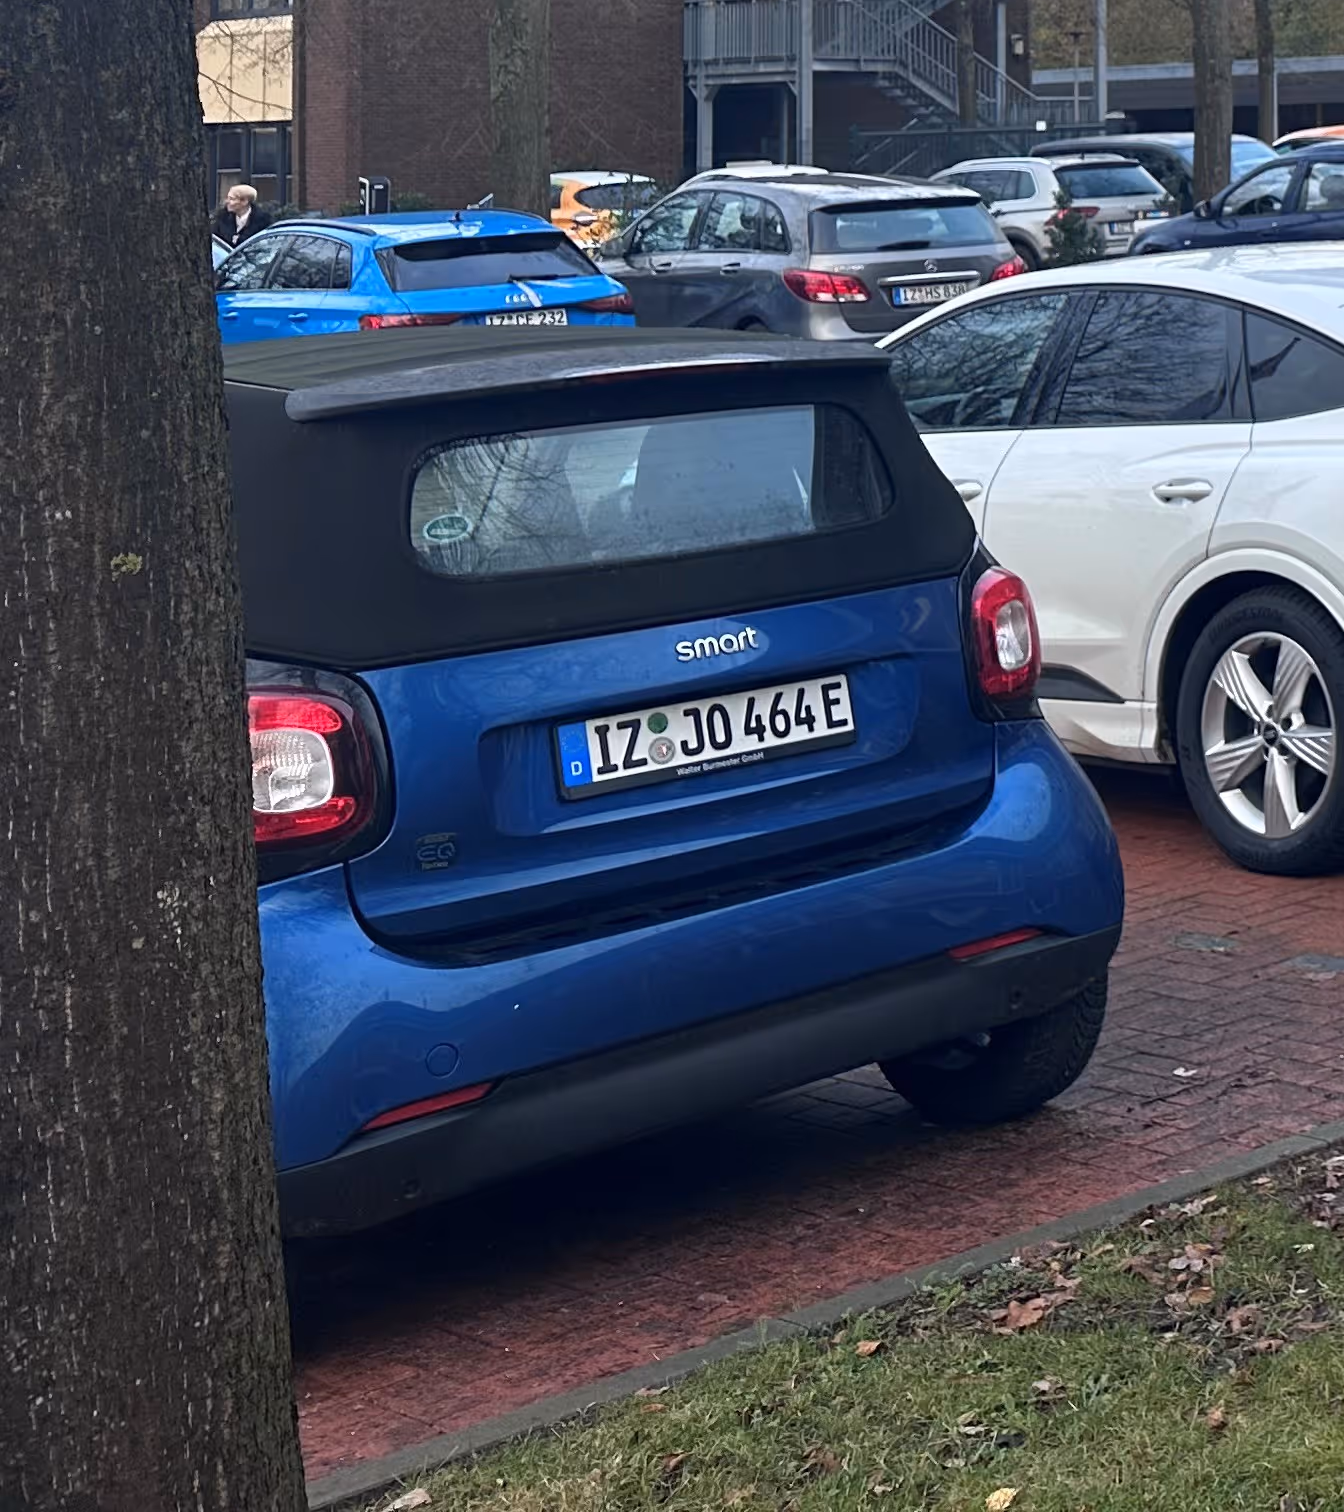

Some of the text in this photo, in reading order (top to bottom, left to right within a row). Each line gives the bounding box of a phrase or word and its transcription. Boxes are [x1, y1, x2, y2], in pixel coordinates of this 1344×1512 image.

[538, 310, 565, 325] 232
[676, 626, 759, 661] smart
[594, 719, 647, 775] IZ
[680, 703, 732, 756] JO
[741, 751, 765, 763] GmbH
[571, 761, 583, 776] D
